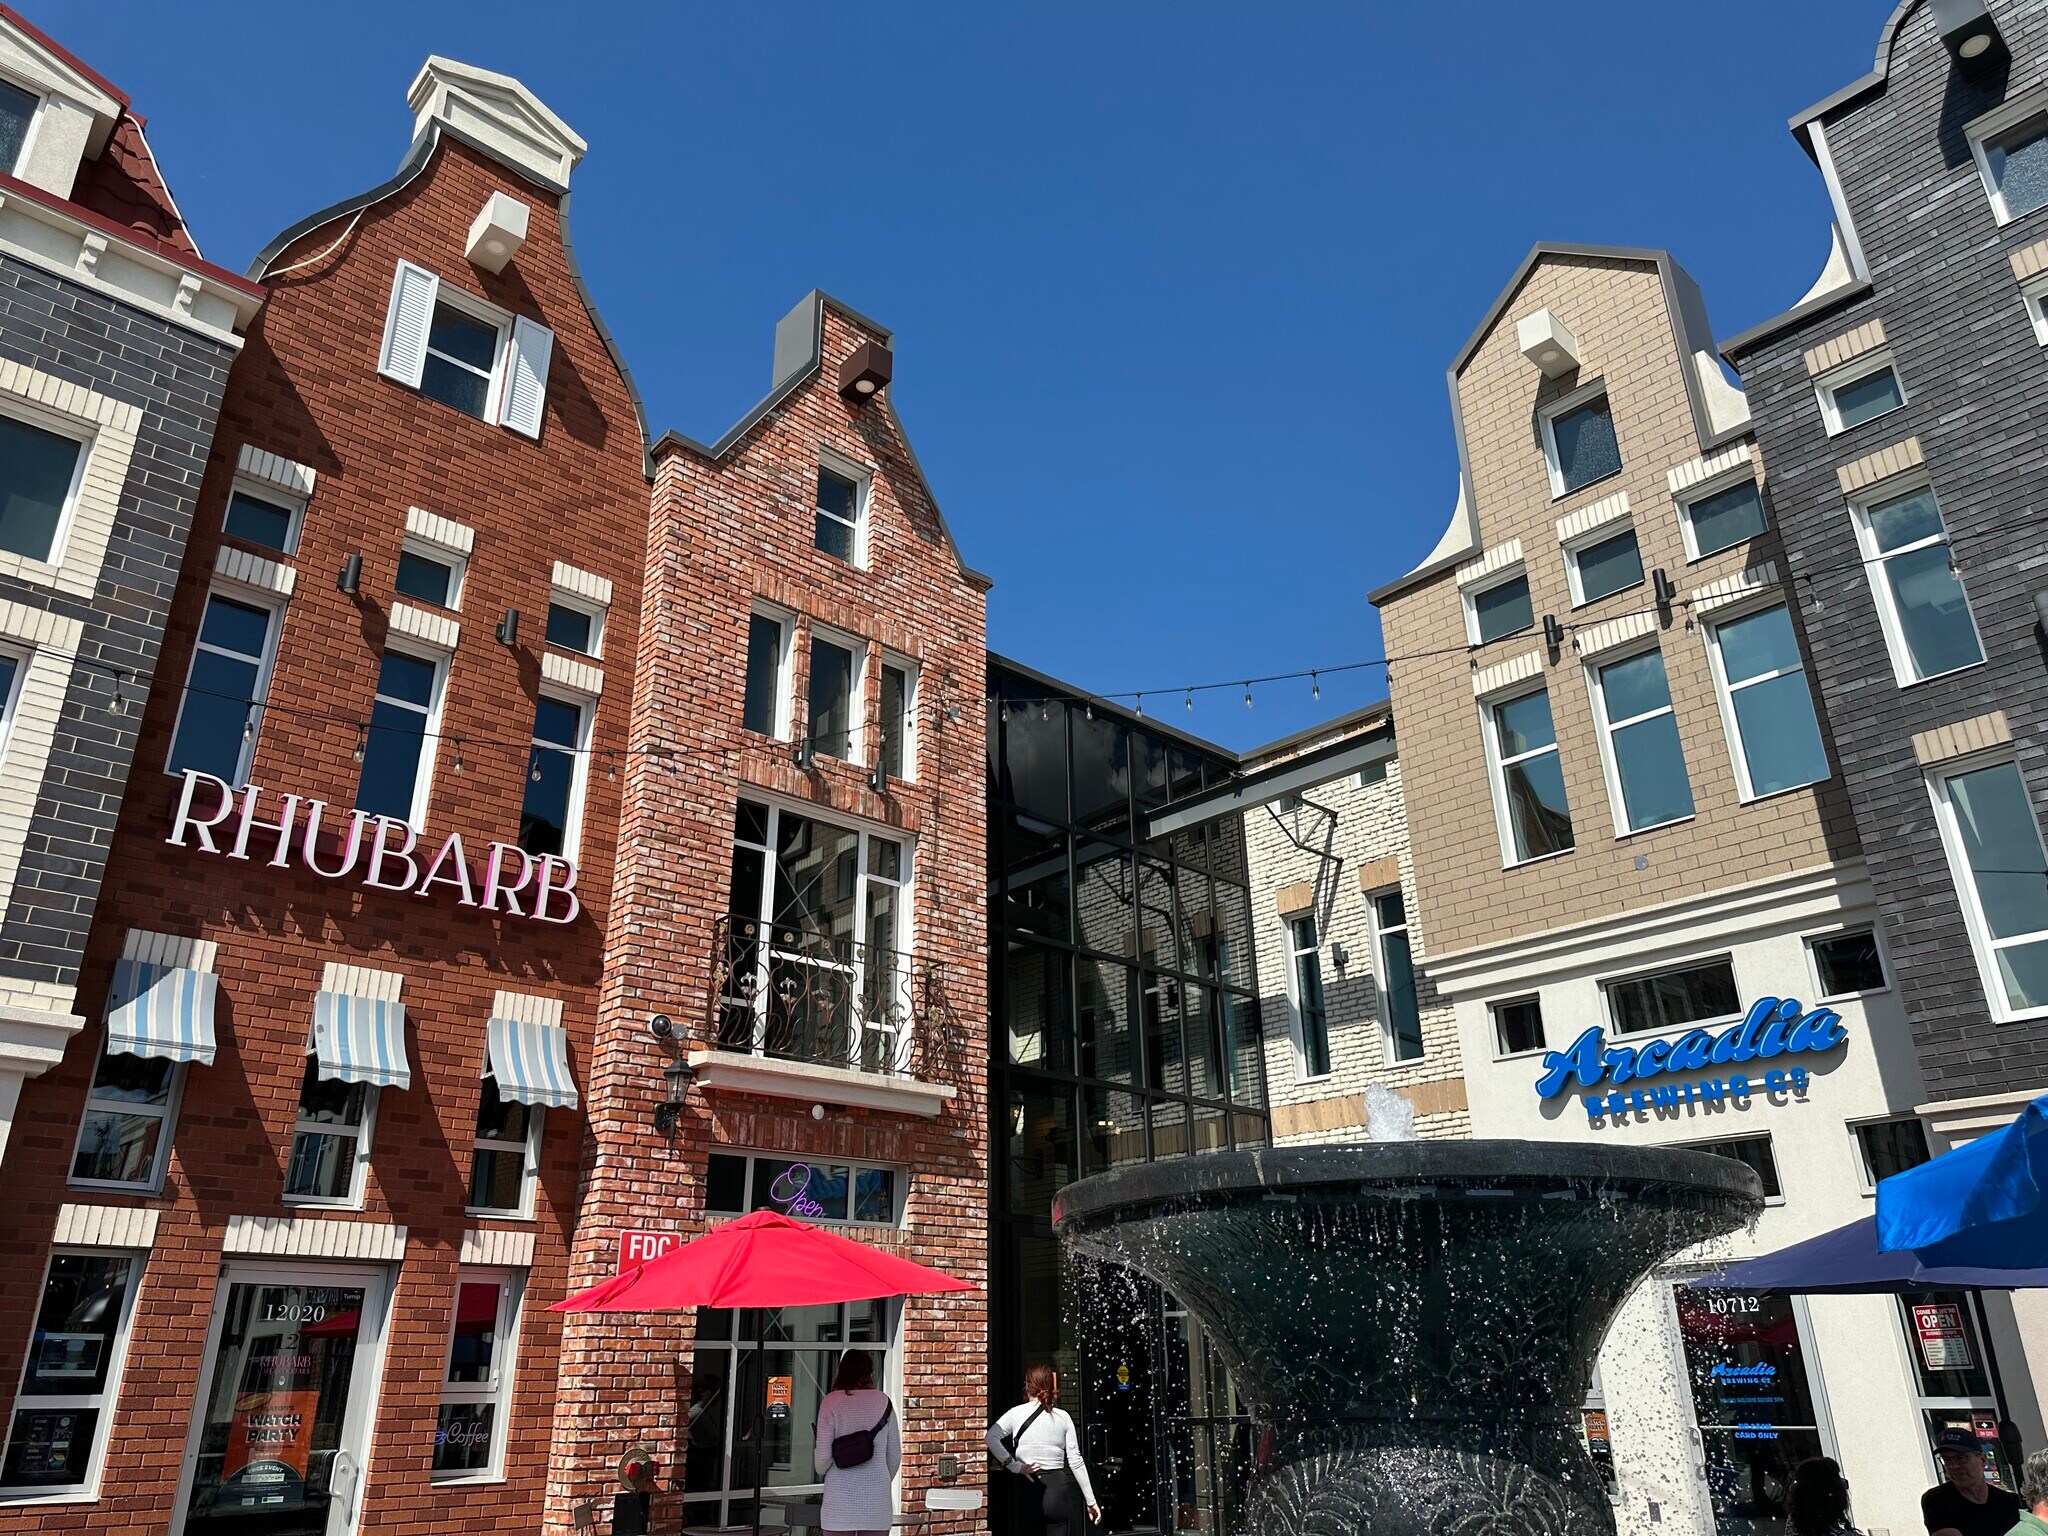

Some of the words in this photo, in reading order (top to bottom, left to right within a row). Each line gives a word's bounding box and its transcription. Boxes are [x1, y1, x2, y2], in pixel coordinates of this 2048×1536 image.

[164, 767, 581, 925] RHUBARB
[1534, 996, 1846, 1099] Arcadia
[1585, 1074, 1749, 1118] BREWING
[770, 1163, 824, 1218] Open
[628, 1234, 671, 1260] FDC
[264, 1303, 326, 1322] 12020
[1706, 1296, 1760, 1314] 10712
[1921, 1313, 1956, 1329] OPEN
[259, 1355, 311, 1368] RHUBARB
[1710, 1362, 1776, 1378] Arcadia
[247, 1413, 303, 1428] WATCH
[245, 1428, 300, 1444] PARTY
[446, 1421, 489, 1447] Coffee
[1734, 1431, 1757, 1439] CARD
[1757, 1431, 1779, 1439] ONLY
[264, 1464, 284, 1473] EVENT
